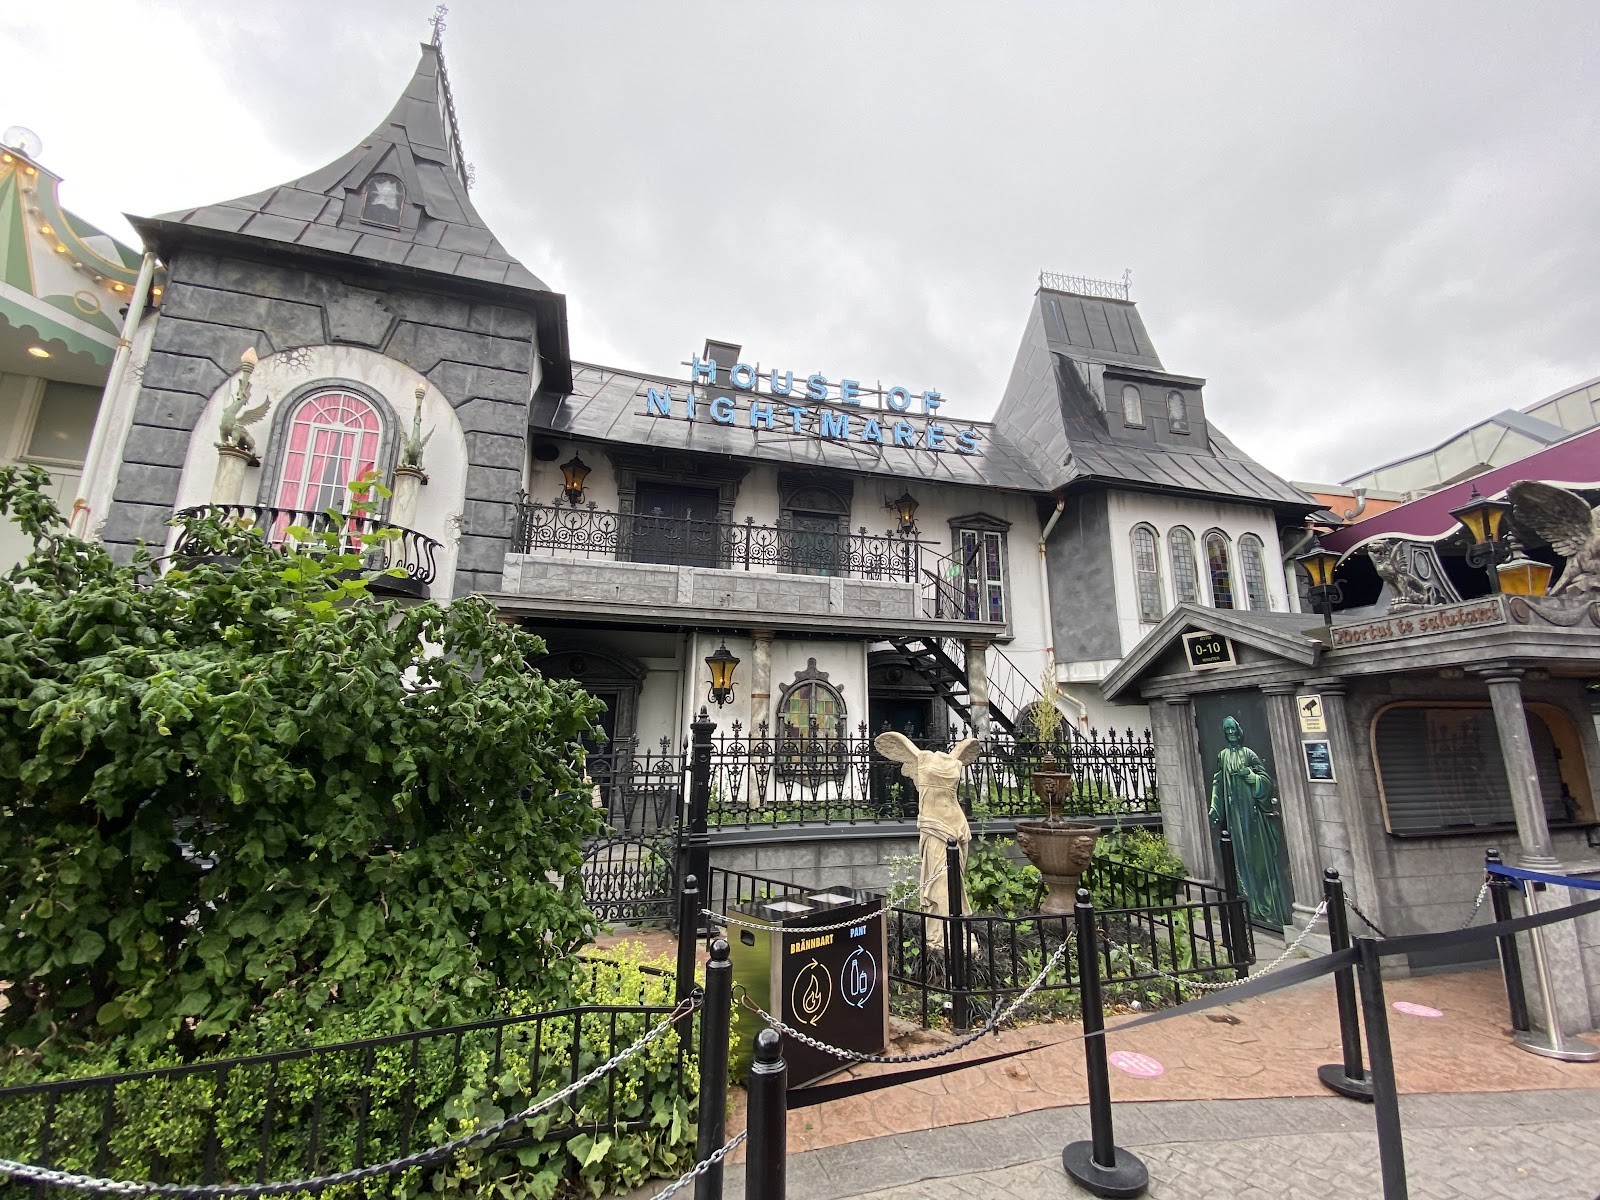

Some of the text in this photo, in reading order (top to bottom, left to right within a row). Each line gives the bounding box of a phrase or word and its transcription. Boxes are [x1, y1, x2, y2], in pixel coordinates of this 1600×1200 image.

[691, 356, 941, 415] HOUSE OF
[646, 387, 979, 455] NIGHTMARES
[1396, 617, 1415, 635] te
[1419, 601, 1500, 633] salutant
[1195, 642, 1221, 656] 0-10
[790, 933, 834, 955] BRÄNNBART
[850, 925, 867, 938] PANT
